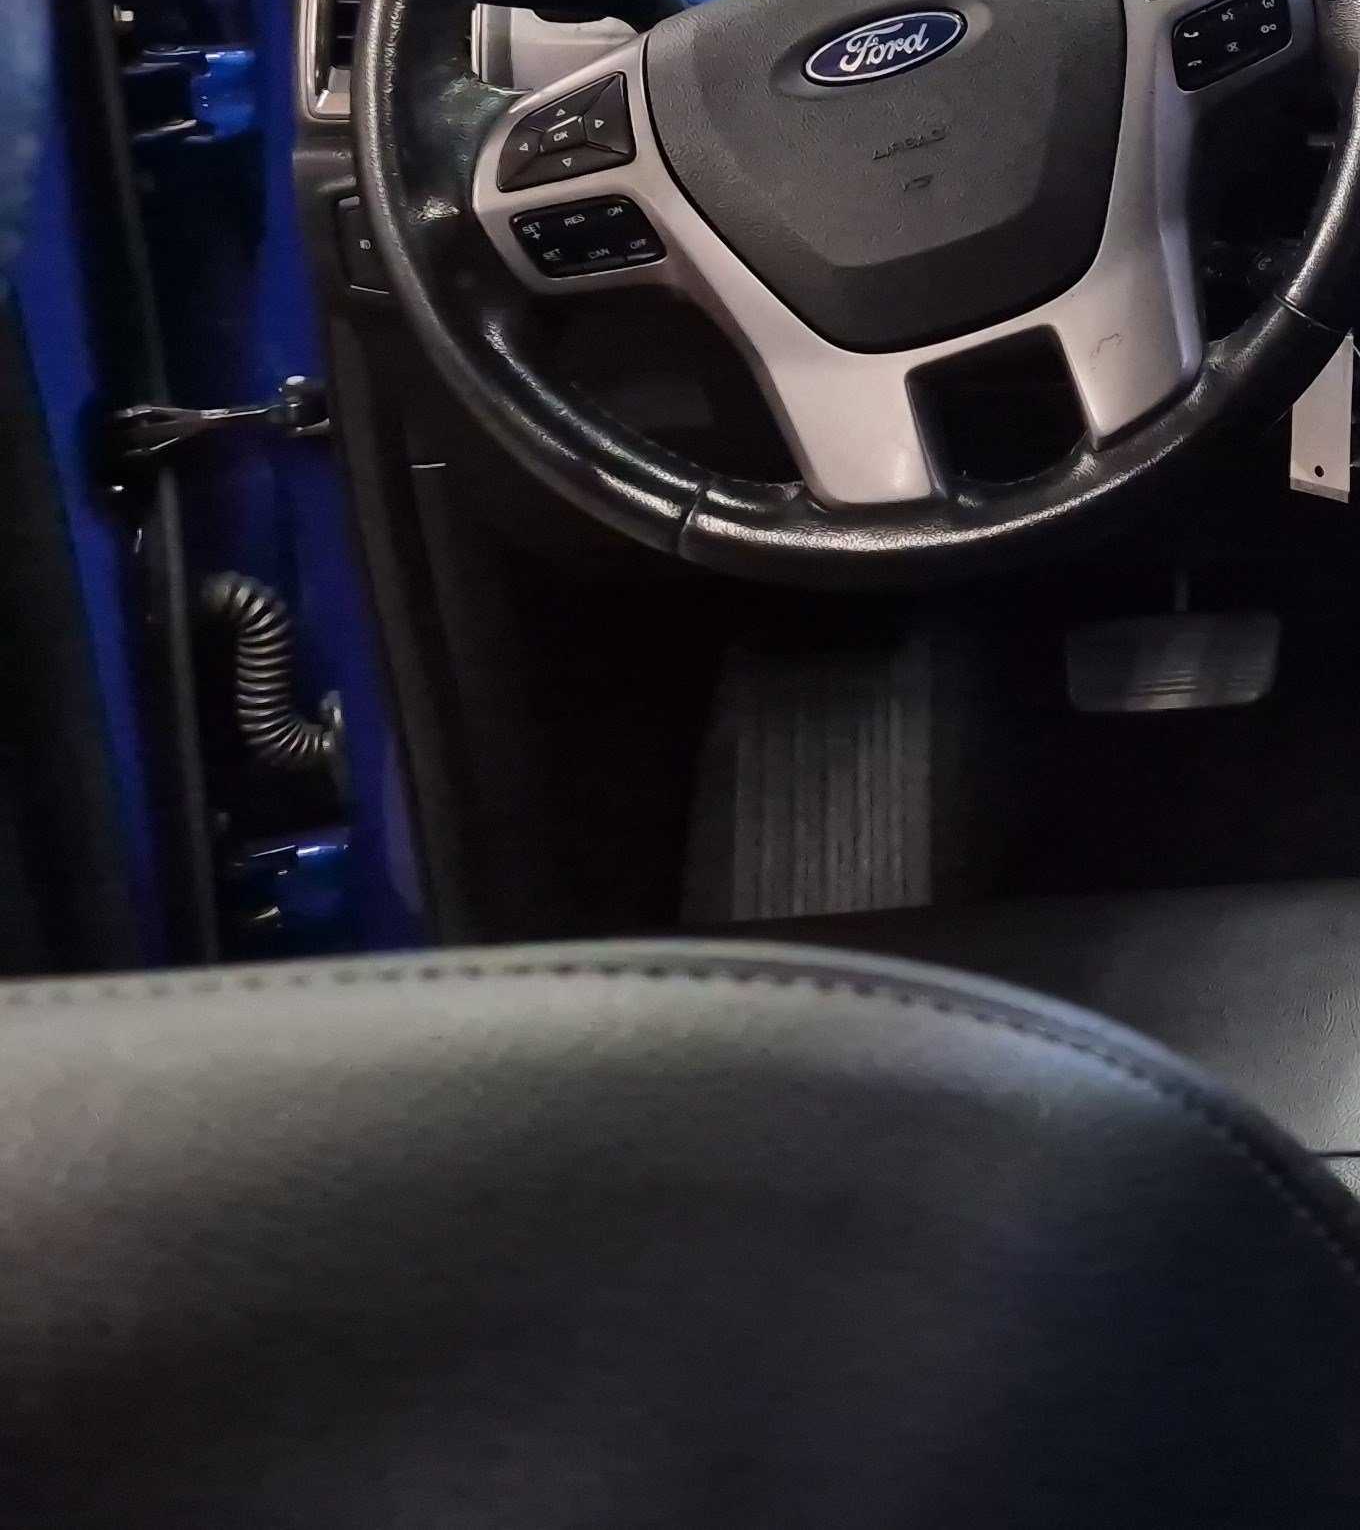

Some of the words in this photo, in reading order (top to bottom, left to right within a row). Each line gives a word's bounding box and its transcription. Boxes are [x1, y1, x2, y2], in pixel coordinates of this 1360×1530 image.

[838, 22, 930, 73] Ford
[552, 130, 568, 142] OK
[606, 205, 624, 217] ON
[564, 213, 586, 227] RES
[522, 221, 541, 235] SET
